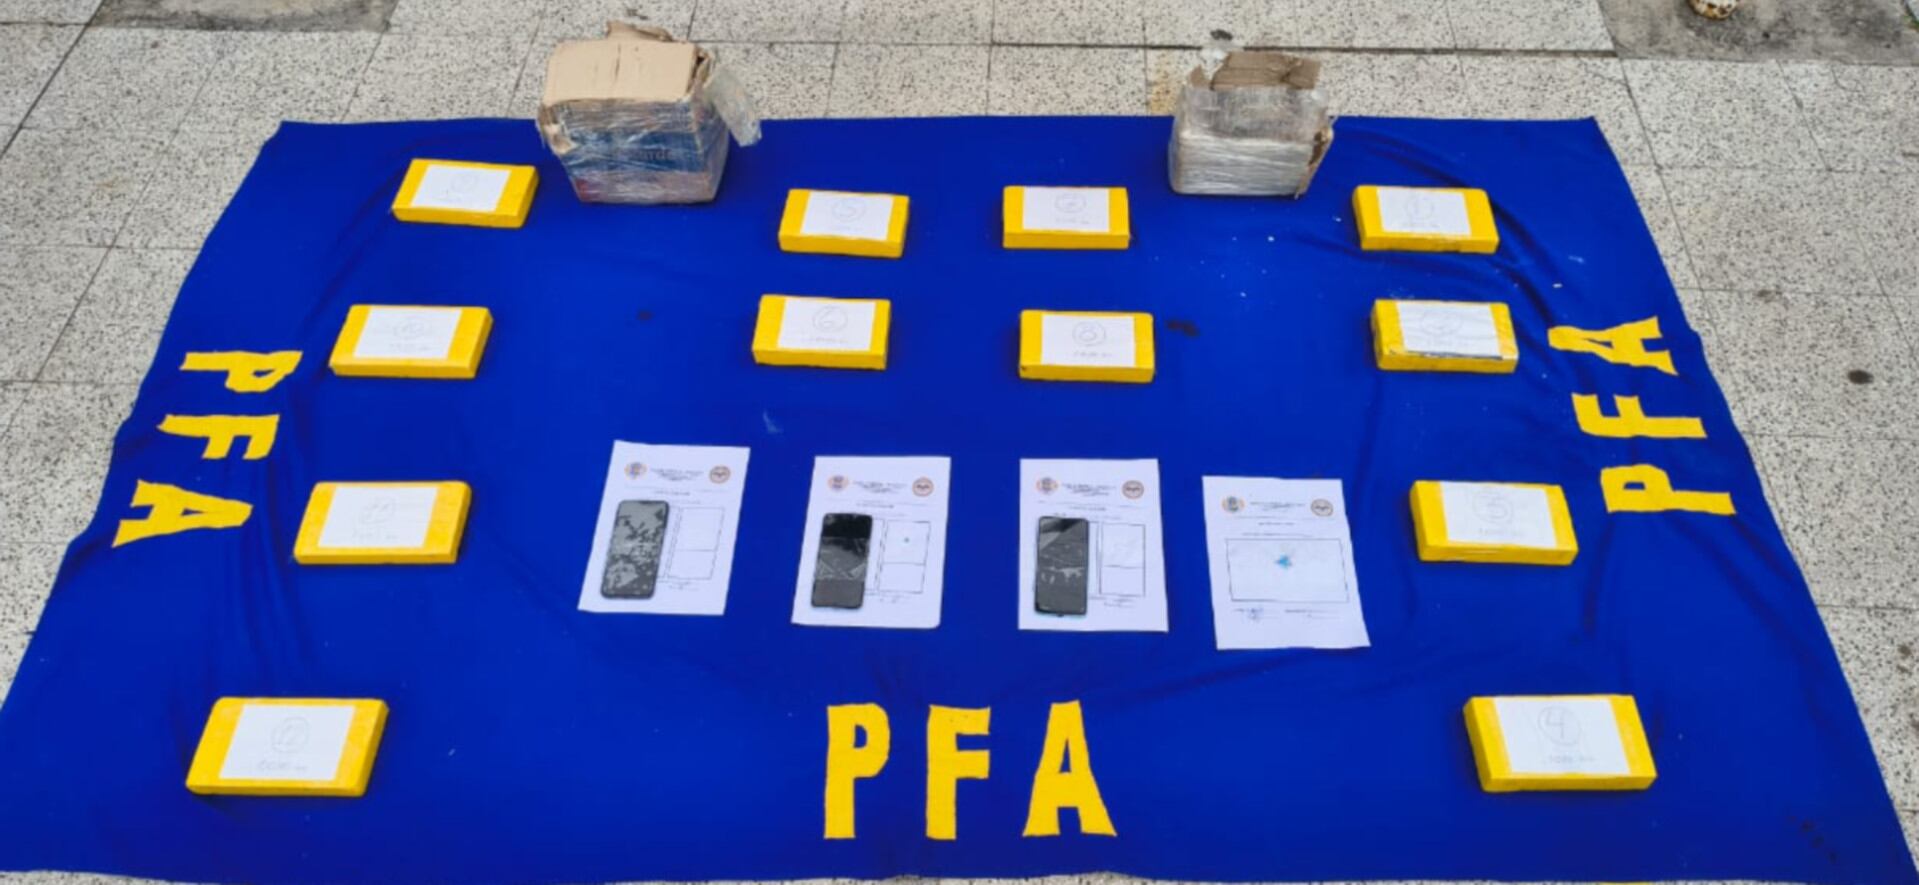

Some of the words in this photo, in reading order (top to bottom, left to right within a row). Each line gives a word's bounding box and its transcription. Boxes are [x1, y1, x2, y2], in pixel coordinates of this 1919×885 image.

[112, 350, 303, 548] PFA
[1547, 316, 1736, 516] PFA
[824, 700, 1117, 840] PFA
